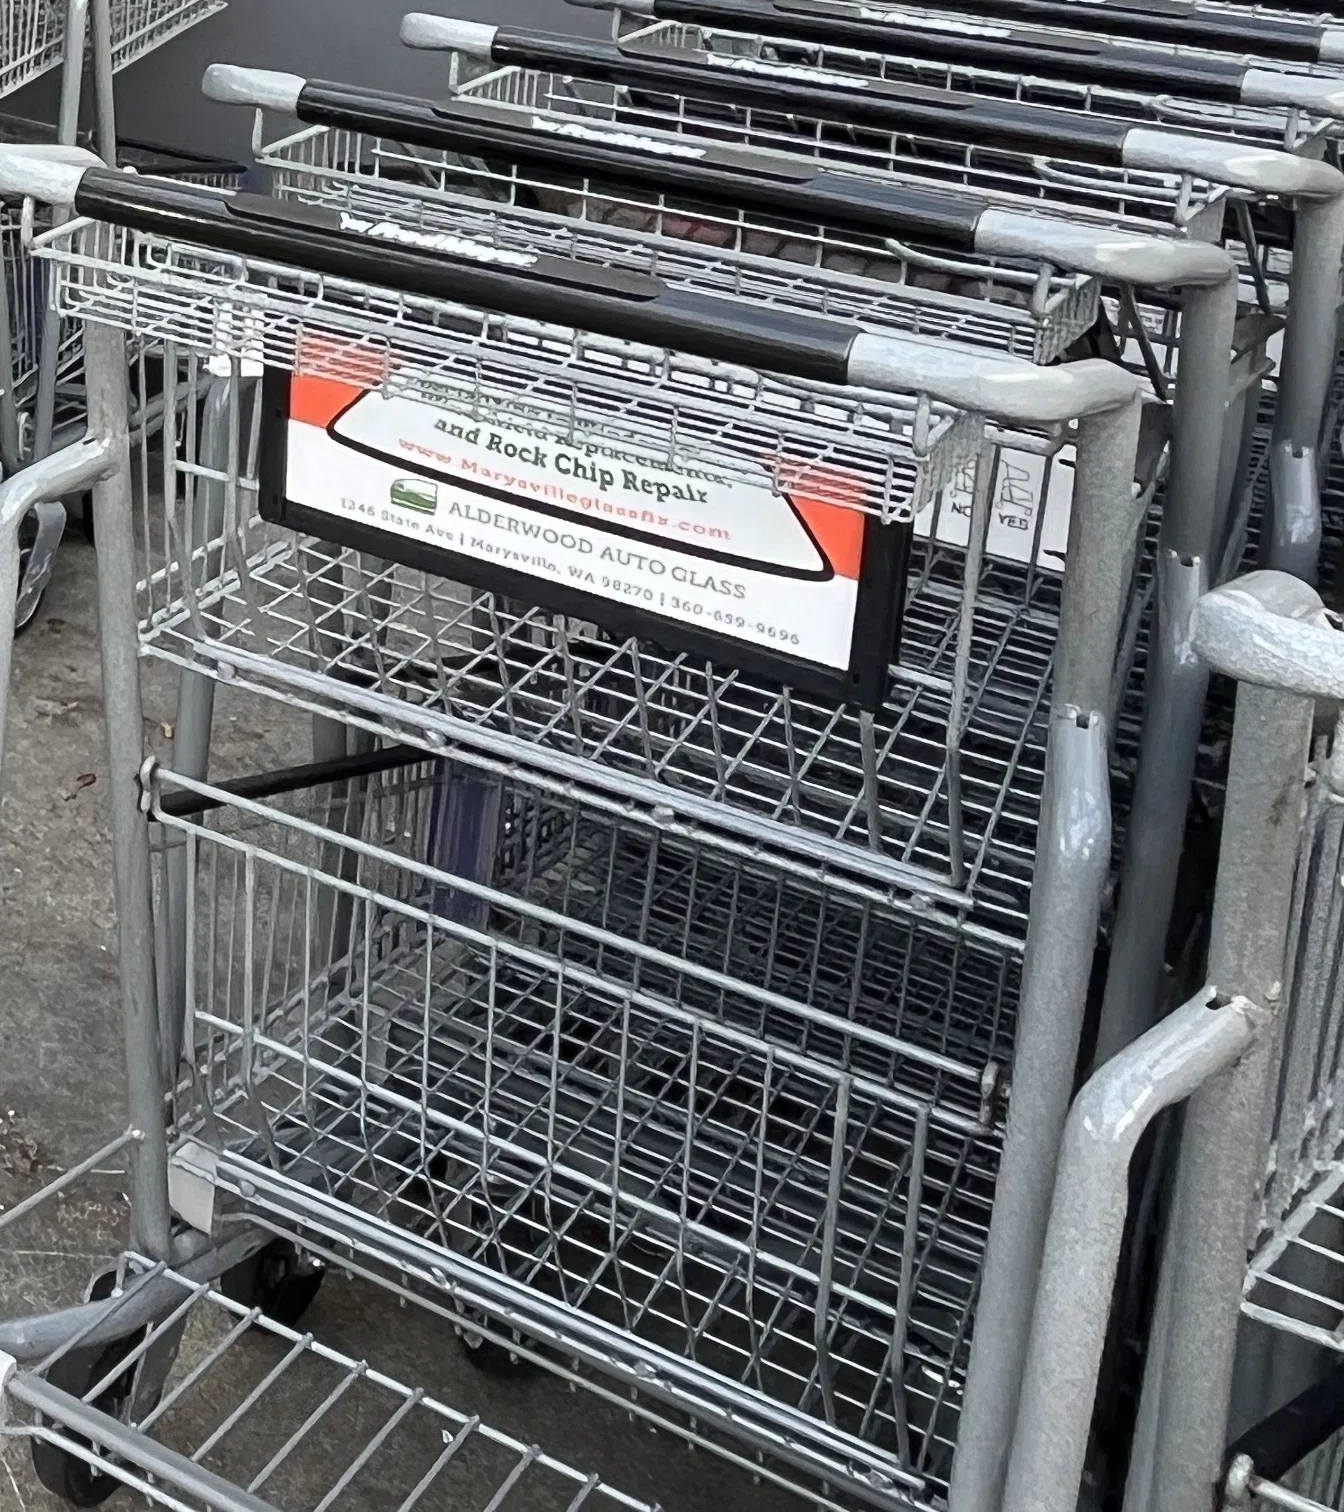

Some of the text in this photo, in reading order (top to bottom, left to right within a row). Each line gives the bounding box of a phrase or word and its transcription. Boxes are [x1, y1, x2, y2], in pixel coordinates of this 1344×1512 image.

[433, 418, 708, 503] and Rock Chip Repair
[381, 510, 420, 531] State
[425, 524, 454, 541] Ave
[567, 565, 595, 585] WA
[601, 576, 653, 601] 98270
[448, 501, 747, 600] ALDERWOOD AUTO GLASS
